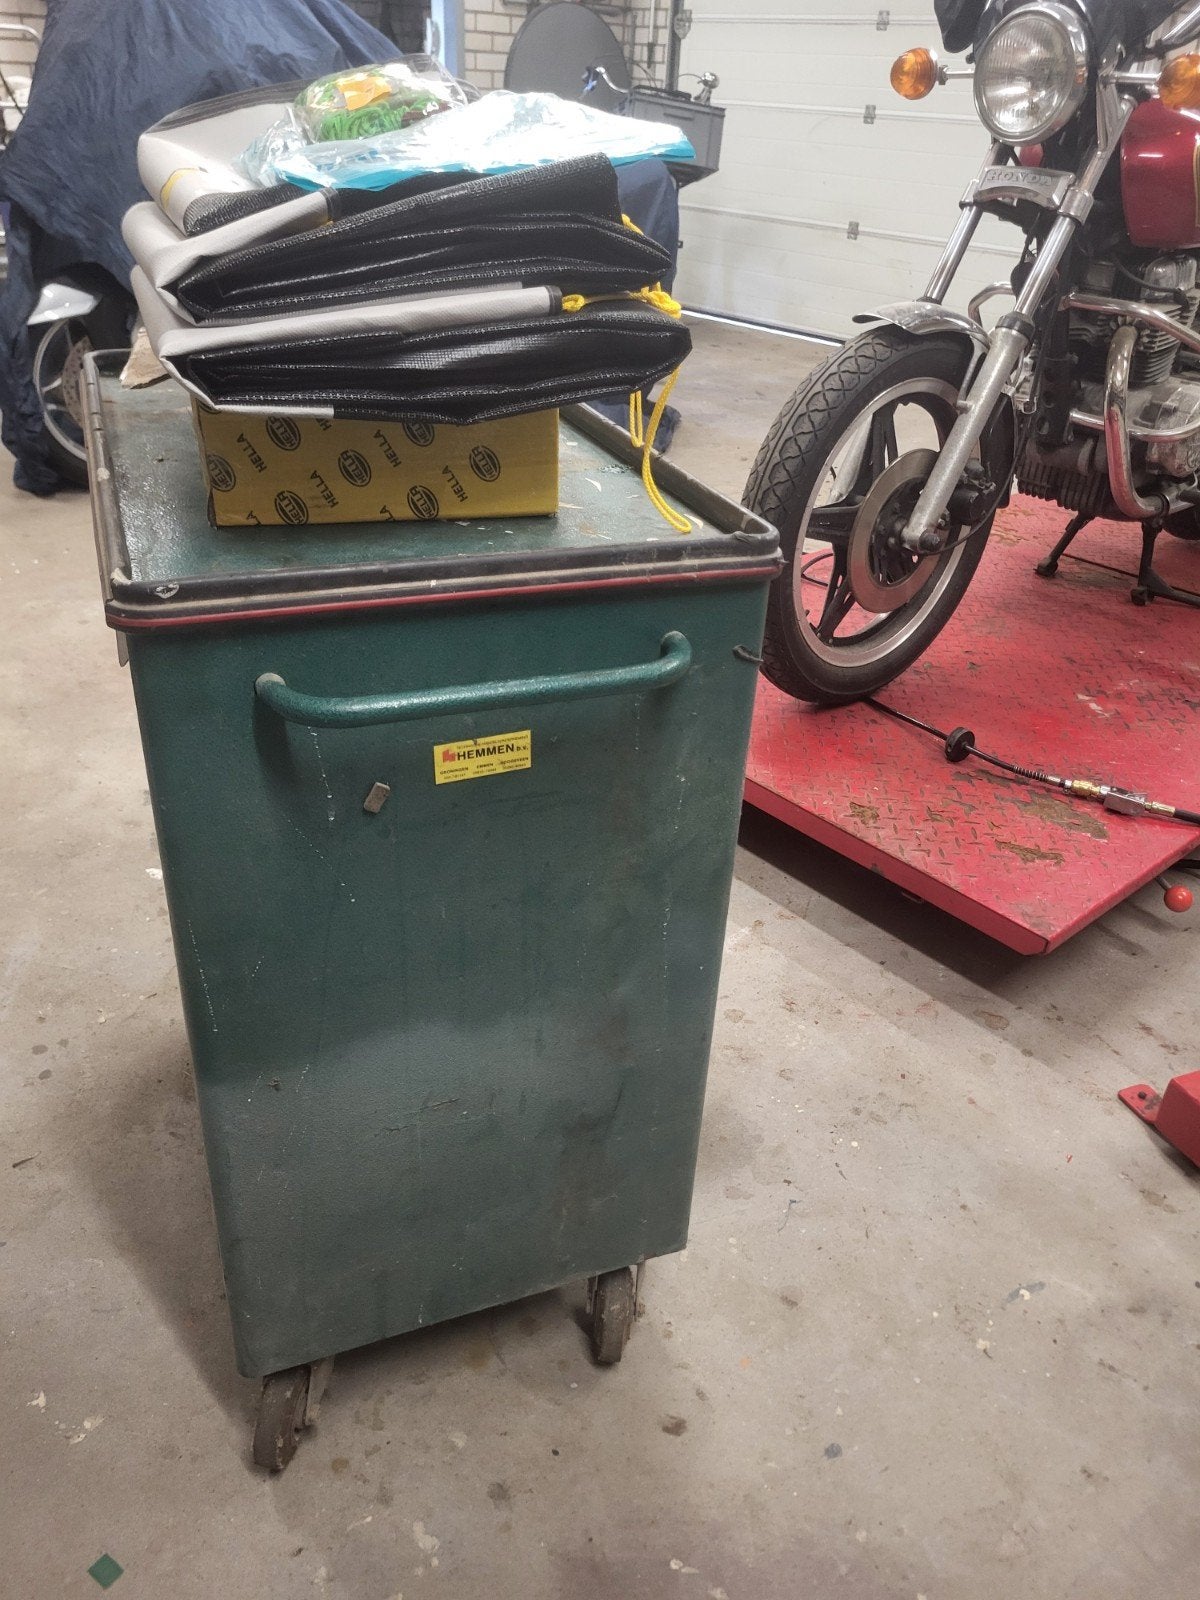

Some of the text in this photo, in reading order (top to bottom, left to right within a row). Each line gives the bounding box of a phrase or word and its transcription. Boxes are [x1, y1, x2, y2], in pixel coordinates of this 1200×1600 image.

[986, 171, 1053, 186] HONDA
[236, 433, 267, 473] HELLA
[373, 429, 402, 468] HELLA
[472, 446, 496, 479] HELLA
[340, 450, 367, 484] HELLA
[441, 465, 468, 503] HELLA
[310, 469, 339, 508] HELLA
[410, 485, 435, 519] HELLA
[276, 490, 304, 524] HELLA
[457, 743, 514, 761] HEMMEN
